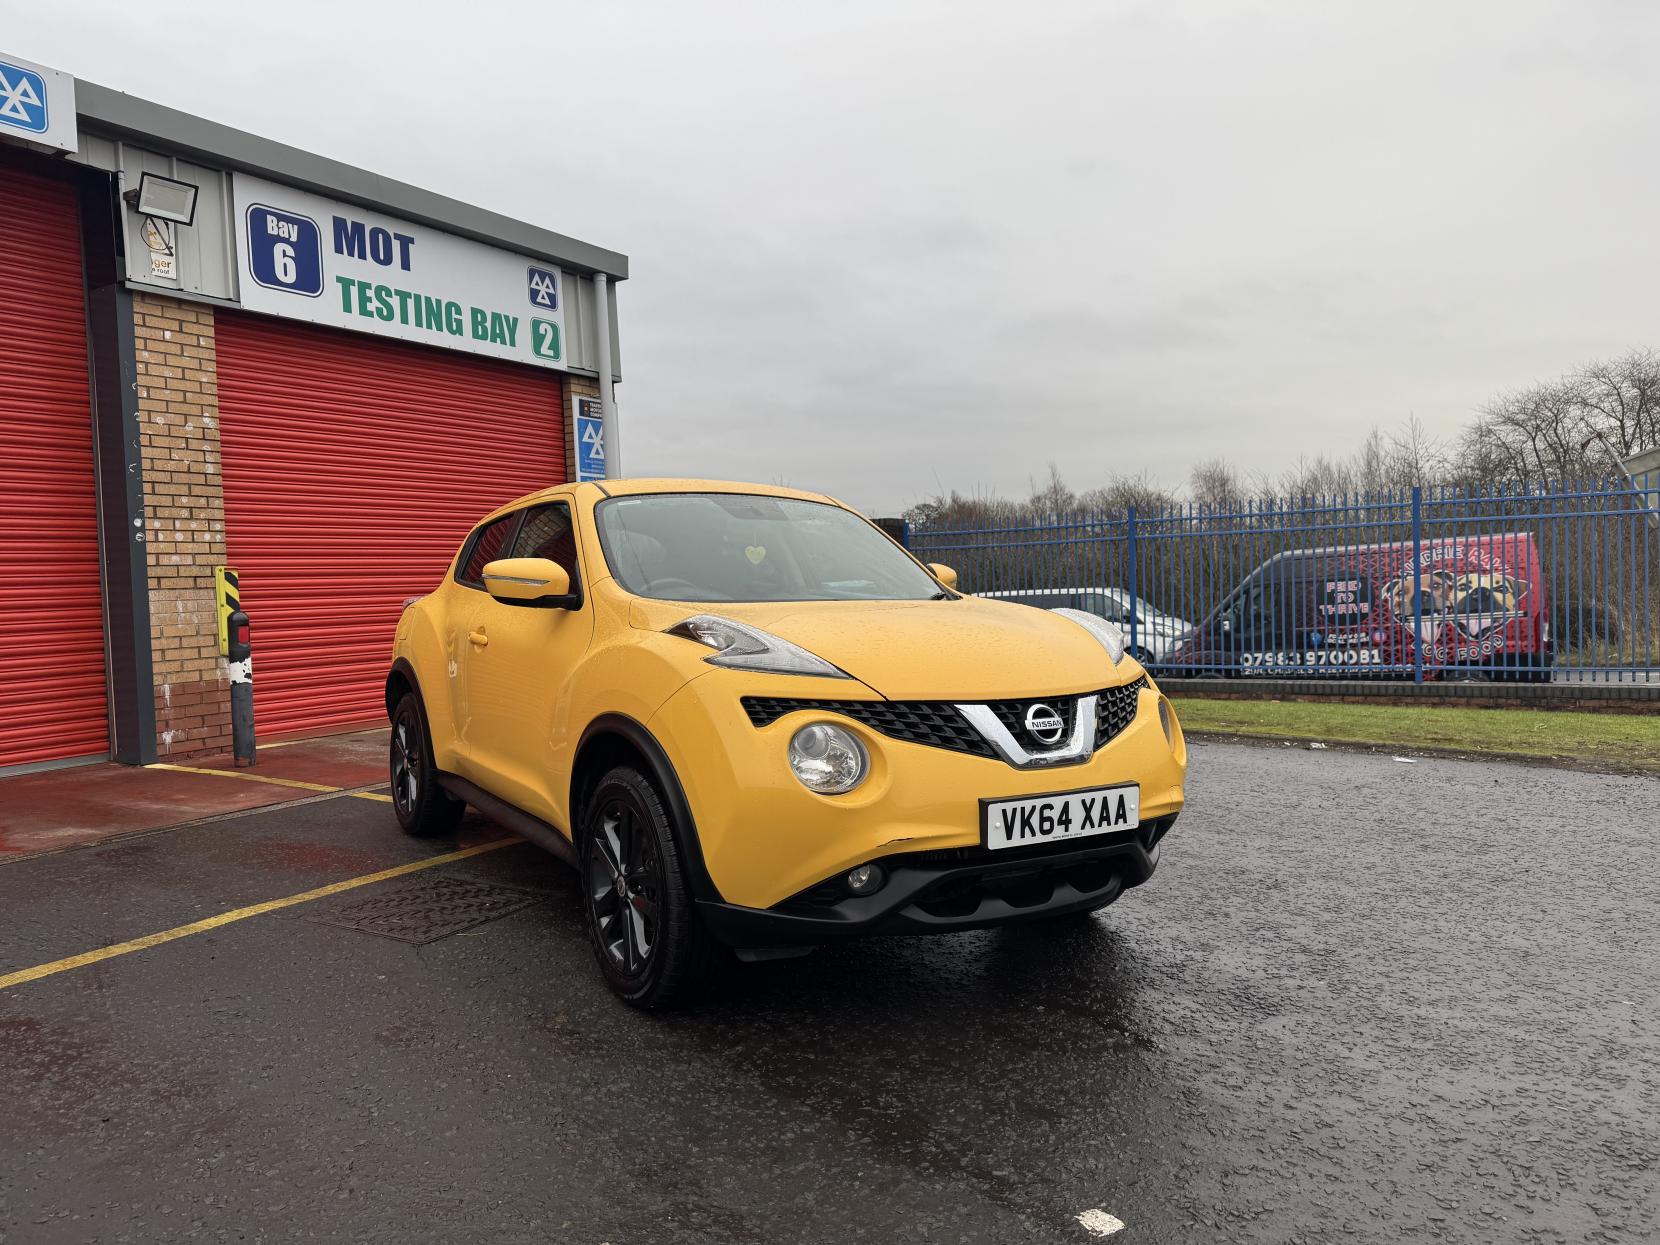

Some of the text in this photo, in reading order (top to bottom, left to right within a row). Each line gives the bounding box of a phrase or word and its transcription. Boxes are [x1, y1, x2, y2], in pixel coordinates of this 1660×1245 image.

[266, 214, 298, 242] Bay
[332, 215, 415, 272] MOT
[151, 260, 171, 268] ger
[273, 242, 297, 284] 6
[335, 275, 554, 358] TESTING BAY 2
[1327, 581, 1362, 592] FEED
[1333, 592, 1354, 603] TO
[1319, 602, 1369, 615] THRIVE
[1240, 648, 1381, 667] 07983 970081
[1457, 634, 1503, 661] FOOD
[1031, 719, 1063, 729] NISSAN
[1002, 793, 1128, 841] VK64 XAA
